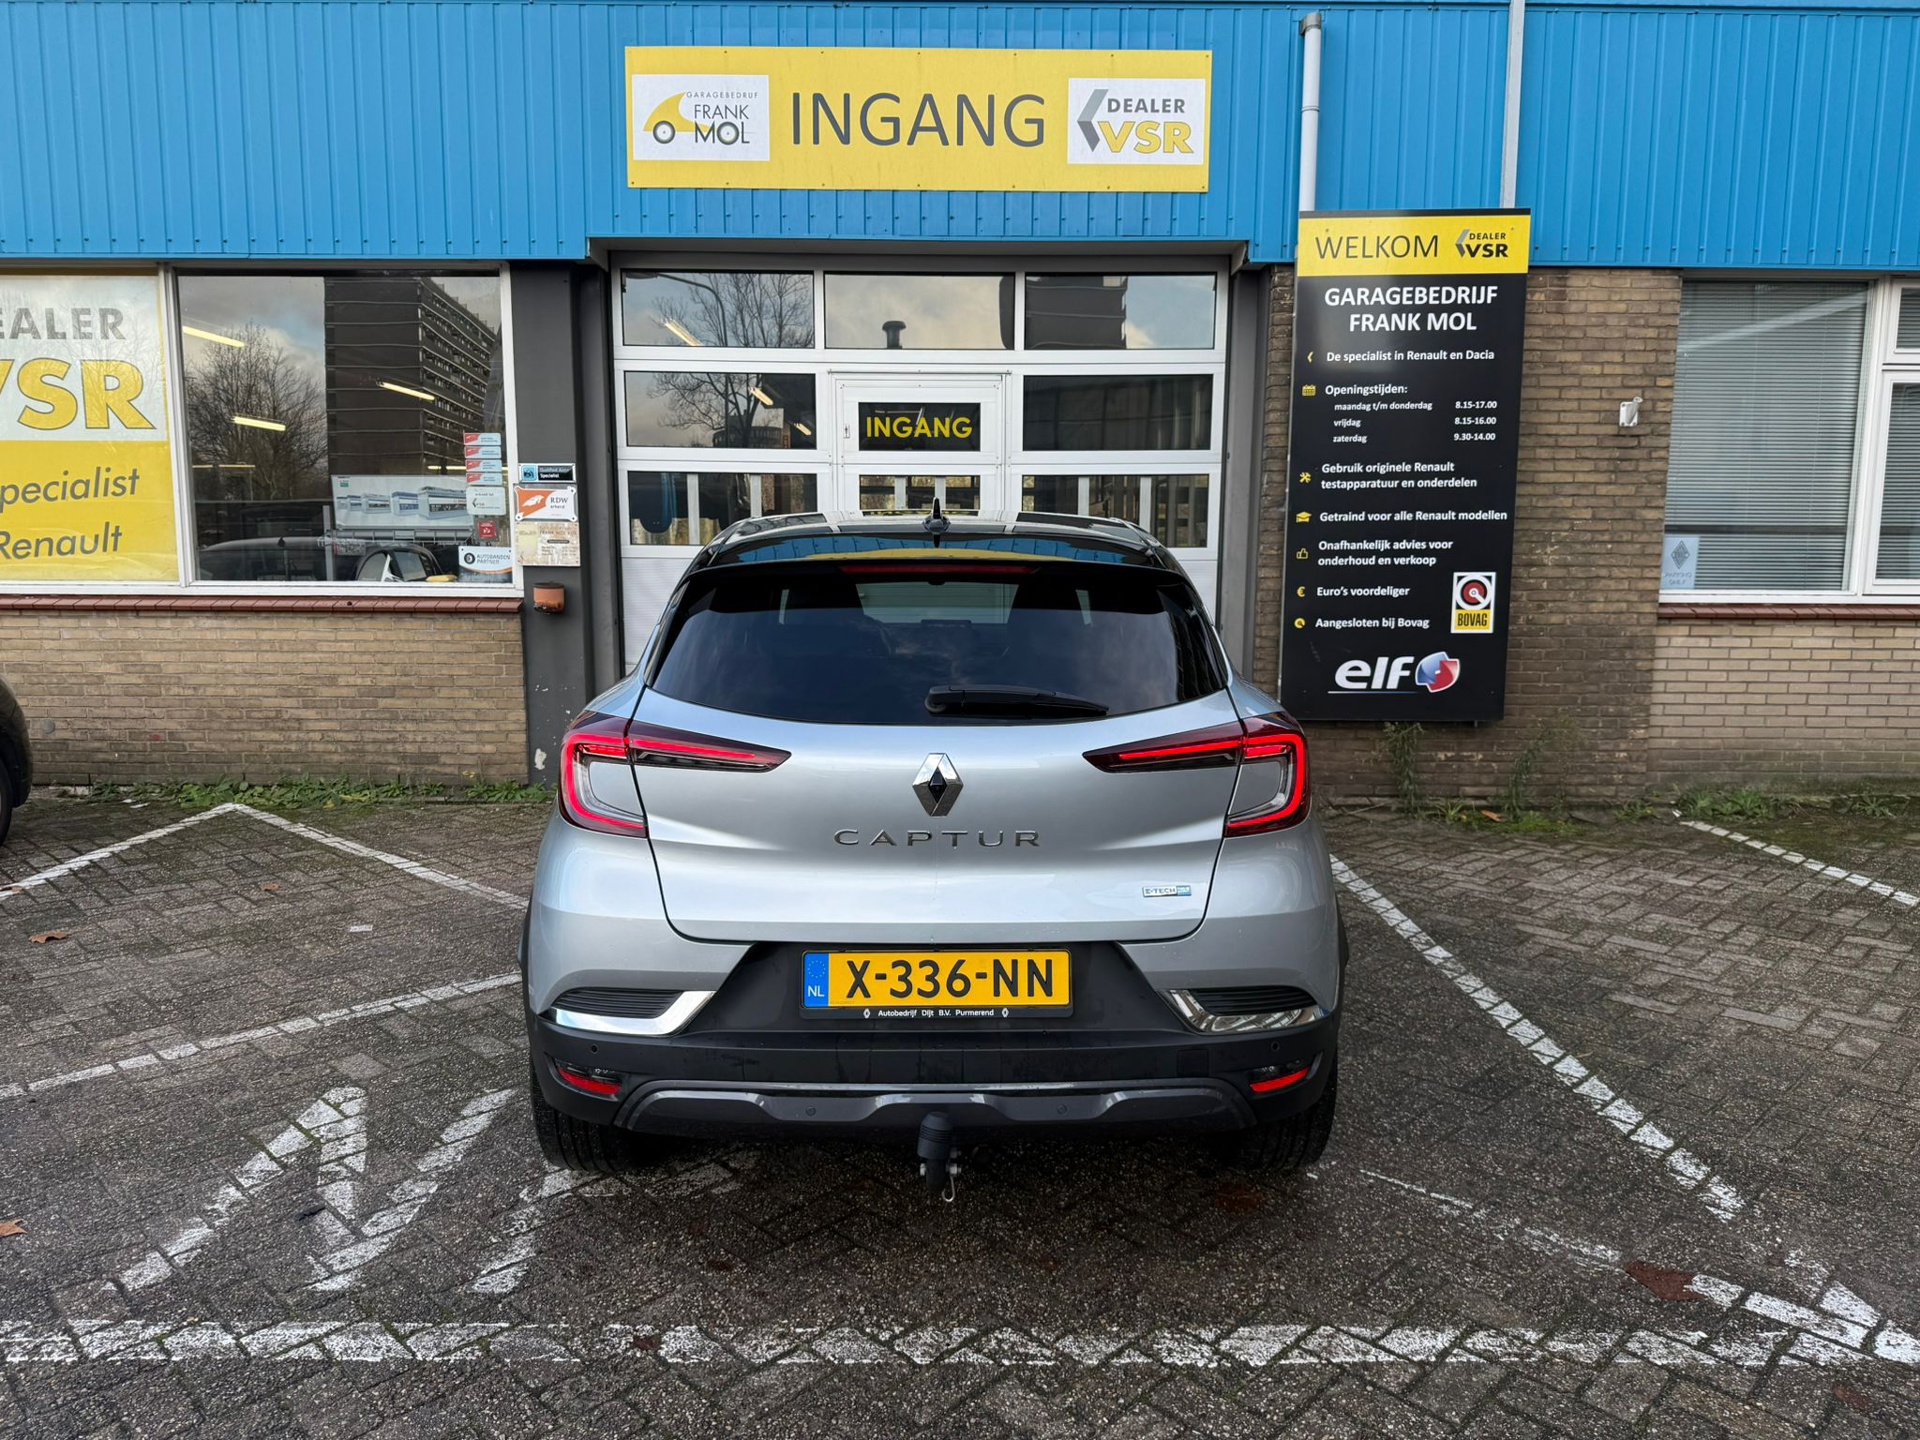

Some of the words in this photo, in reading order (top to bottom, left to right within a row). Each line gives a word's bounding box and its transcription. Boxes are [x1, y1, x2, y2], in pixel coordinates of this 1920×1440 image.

[694, 104, 749, 119] FRANK
[1107, 98, 1185, 113] DEALER
[792, 91, 1045, 148] INGANG
[694, 121, 750, 145] MOL
[1097, 120, 1194, 154] VSR
[1469, 232, 1506, 240] DEALER
[1315, 235, 1438, 259] WELKOM
[1464, 243, 1508, 258] VSR
[1325, 286, 1498, 305] GARAGEBEDRIJF
[0, 307, 126, 340] ALER
[1349, 313, 1420, 332] FRANK
[1427, 312, 1477, 331] MOL
[1327, 352, 1341, 361] De
[1343, 350, 1392, 363] specialist
[1394, 351, 1404, 361] in
[1407, 350, 1447, 361] Renault
[1450, 352, 1463, 360] en
[1466, 349, 1495, 360] Dacia
[0, 357, 157, 431] SR
[1325, 385, 1408, 396] Openingstijden:
[1334, 402, 1372, 412] maandag
[1373, 402, 1388, 410] t/m
[1389, 401, 1432, 411] donderdag
[1455, 400, 1497, 409] 8.15-17.00
[866, 416, 973, 438] INGANG
[1333, 418, 1361, 428] vrijdag
[1455, 417, 1496, 425] 8.15-16.00
[1333, 434, 1367, 444] zaterdag
[1454, 433, 1496, 442] 9.30-14.00
[1322, 464, 1363, 473] Gebruik
[1366, 463, 1412, 474] originele
[1414, 462, 1455, 472] Renault
[1321, 478, 1399, 490] testapparatuur
[1401, 480, 1414, 488] en
[1417, 478, 1477, 488] onderdelen
[1320, 511, 1365, 522] Getraind
[1367, 513, 1391, 521] voor
[1394, 511, 1413, 520] alle
[1416, 511, 1456, 520] Renault
[1458, 511, 1507, 520] modellen
[1318, 540, 1390, 551] Onafhankelijk
[1393, 540, 1426, 550] advies
[1429, 541, 1453, 549] voor
[1318, 556, 1375, 566] onderhoud
[1378, 558, 1391, 566] en
[1394, 556, 1436, 567] verkoop
[1350, 586, 1410, 598] voordeliger
[1316, 618, 1379, 628] Aangesloten
[1382, 617, 1395, 628] bij
[1398, 618, 1430, 629] Bovag
[1457, 614, 1488, 627] BOVAG
[1334, 656, 1414, 690] elf
[834, 830, 1040, 847] CAPTUR
[846, 959, 1053, 998] X-336-NN
[808, 985, 825, 997] NL
[878, 1010, 917, 1018] Autobedrijf
[955, 1008, 994, 1016] Purmerend
